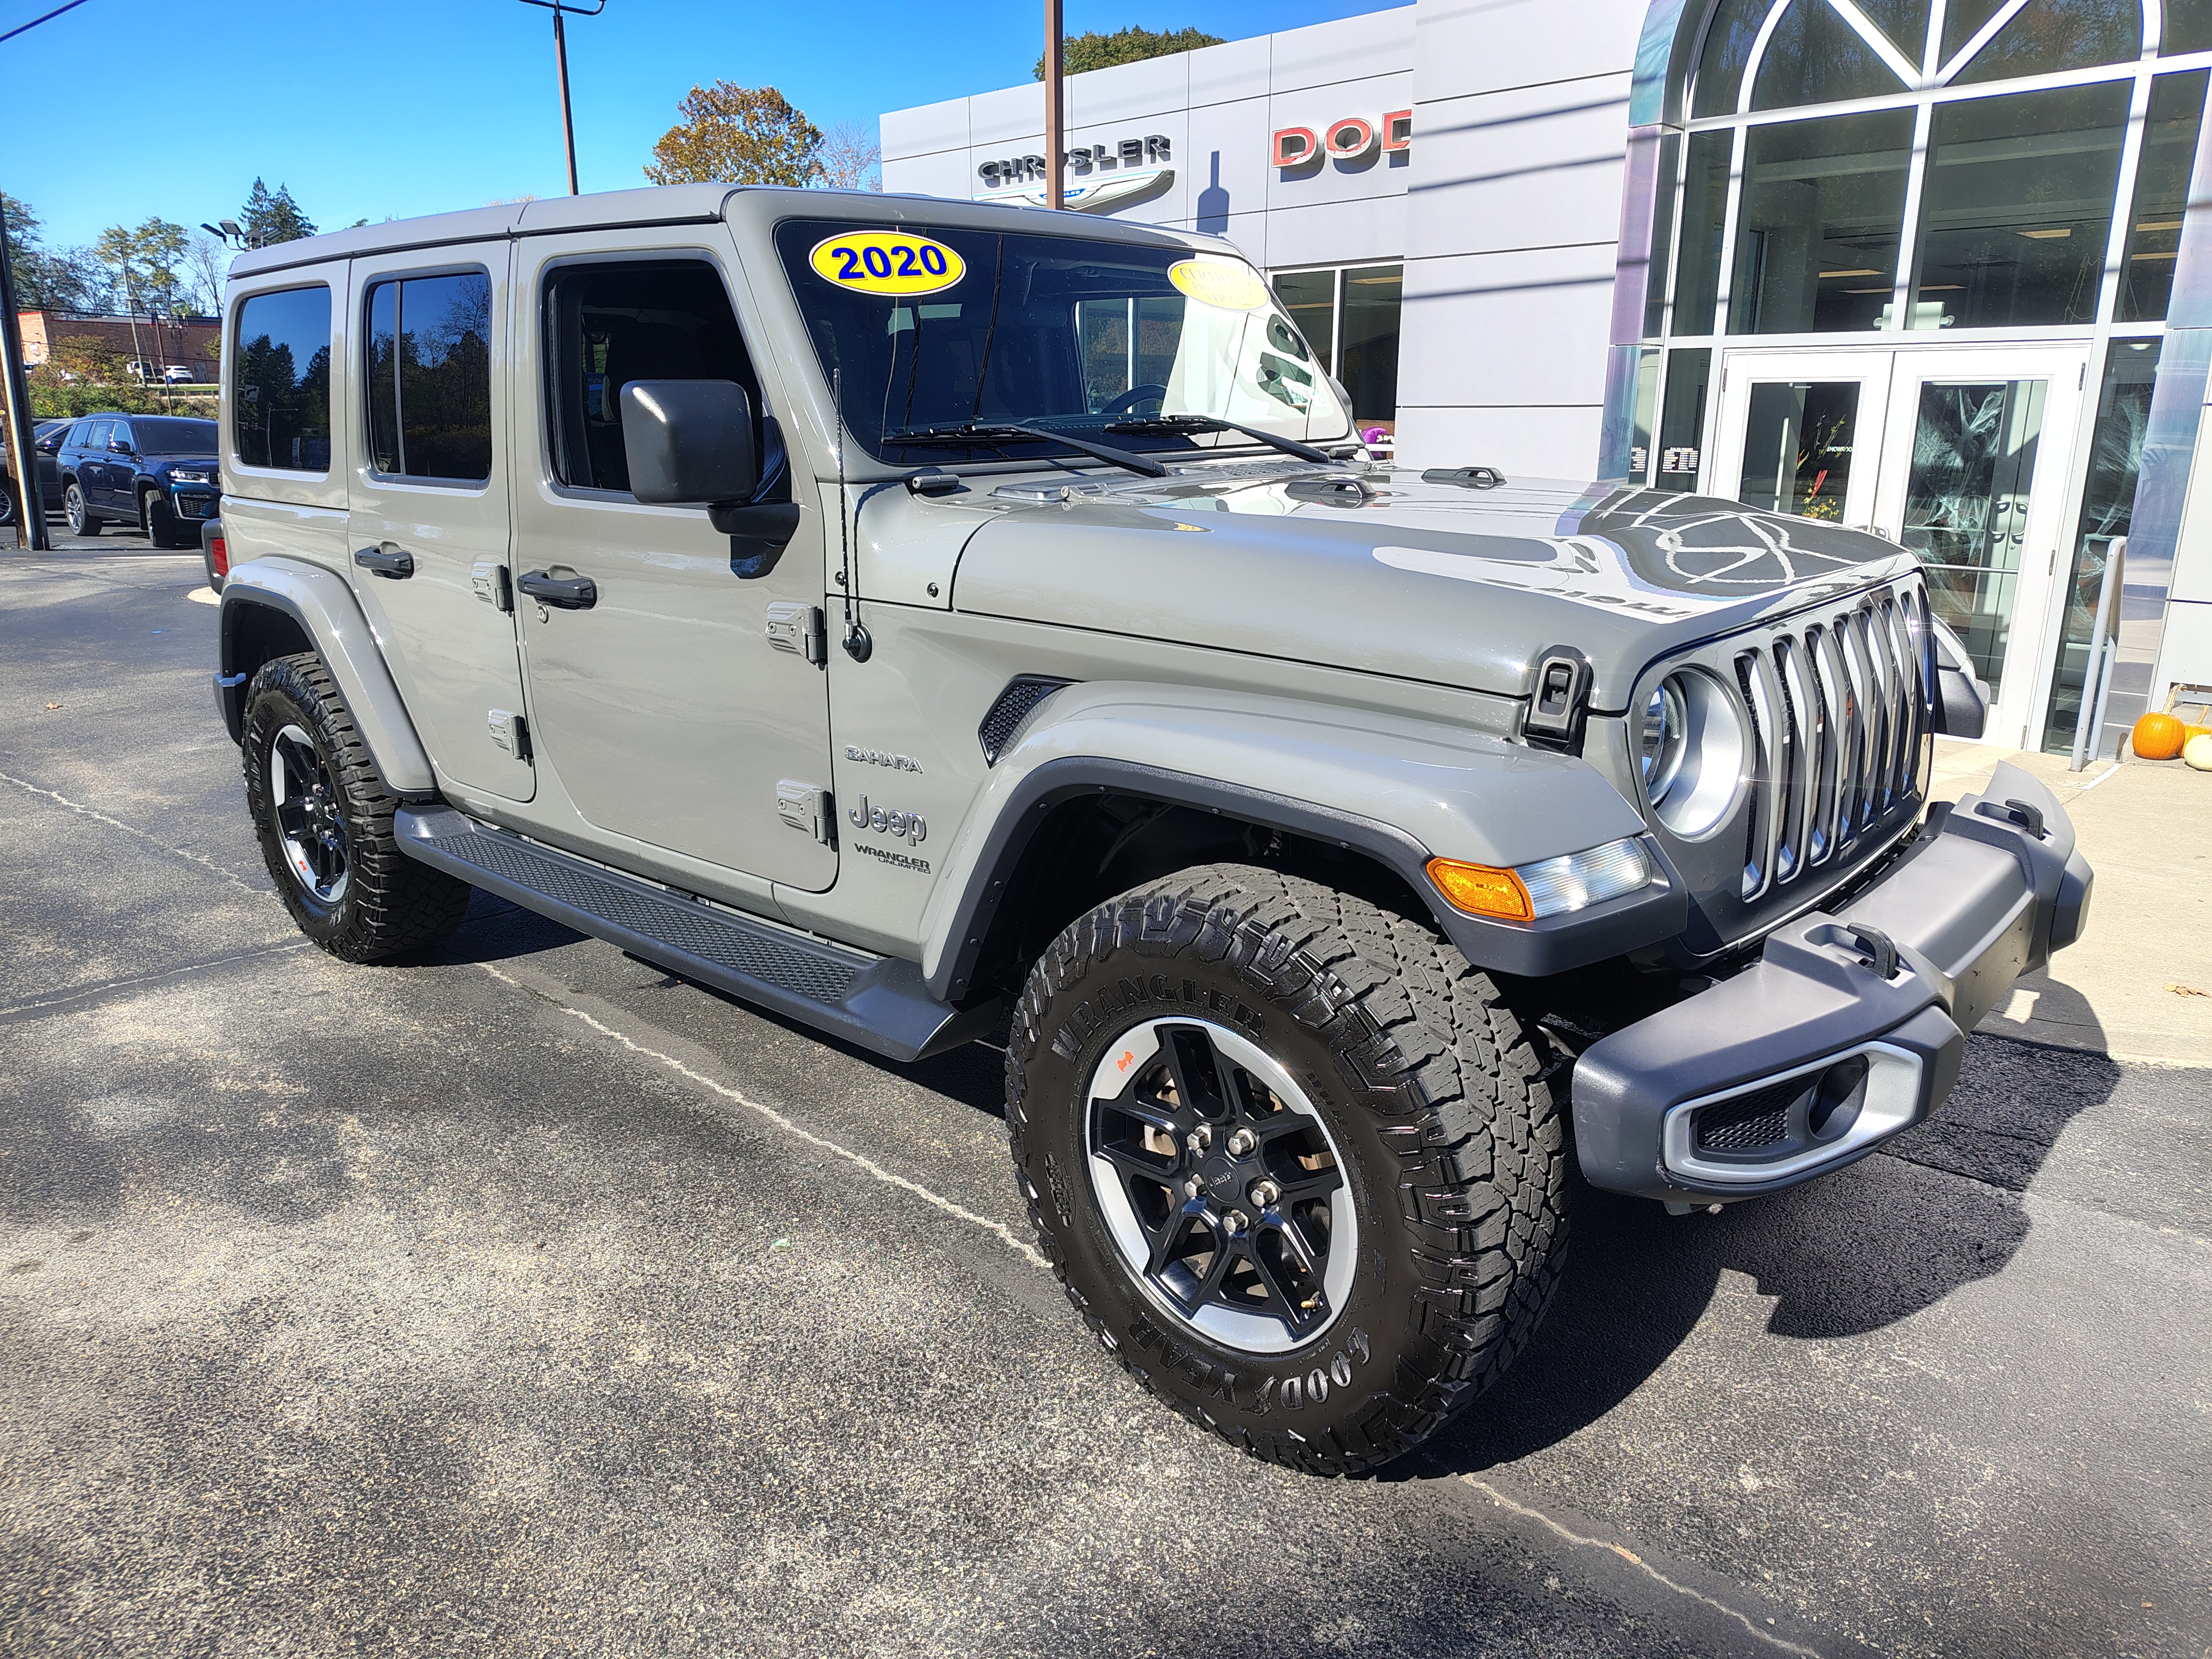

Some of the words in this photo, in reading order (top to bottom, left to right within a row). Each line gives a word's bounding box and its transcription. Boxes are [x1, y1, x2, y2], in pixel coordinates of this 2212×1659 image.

[978, 135, 1170, 179] CHRSLER
[832, 245, 948, 281] 2020
[845, 745, 923, 774] SAHARA
[848, 794, 927, 847] Jeep
[854, 842, 930, 870] WRANGLER
[878, 857, 931, 874] UNLIMITED
[1051, 973, 1266, 1065] WRANGLER
[1209, 1171, 1233, 1189] Jeep
